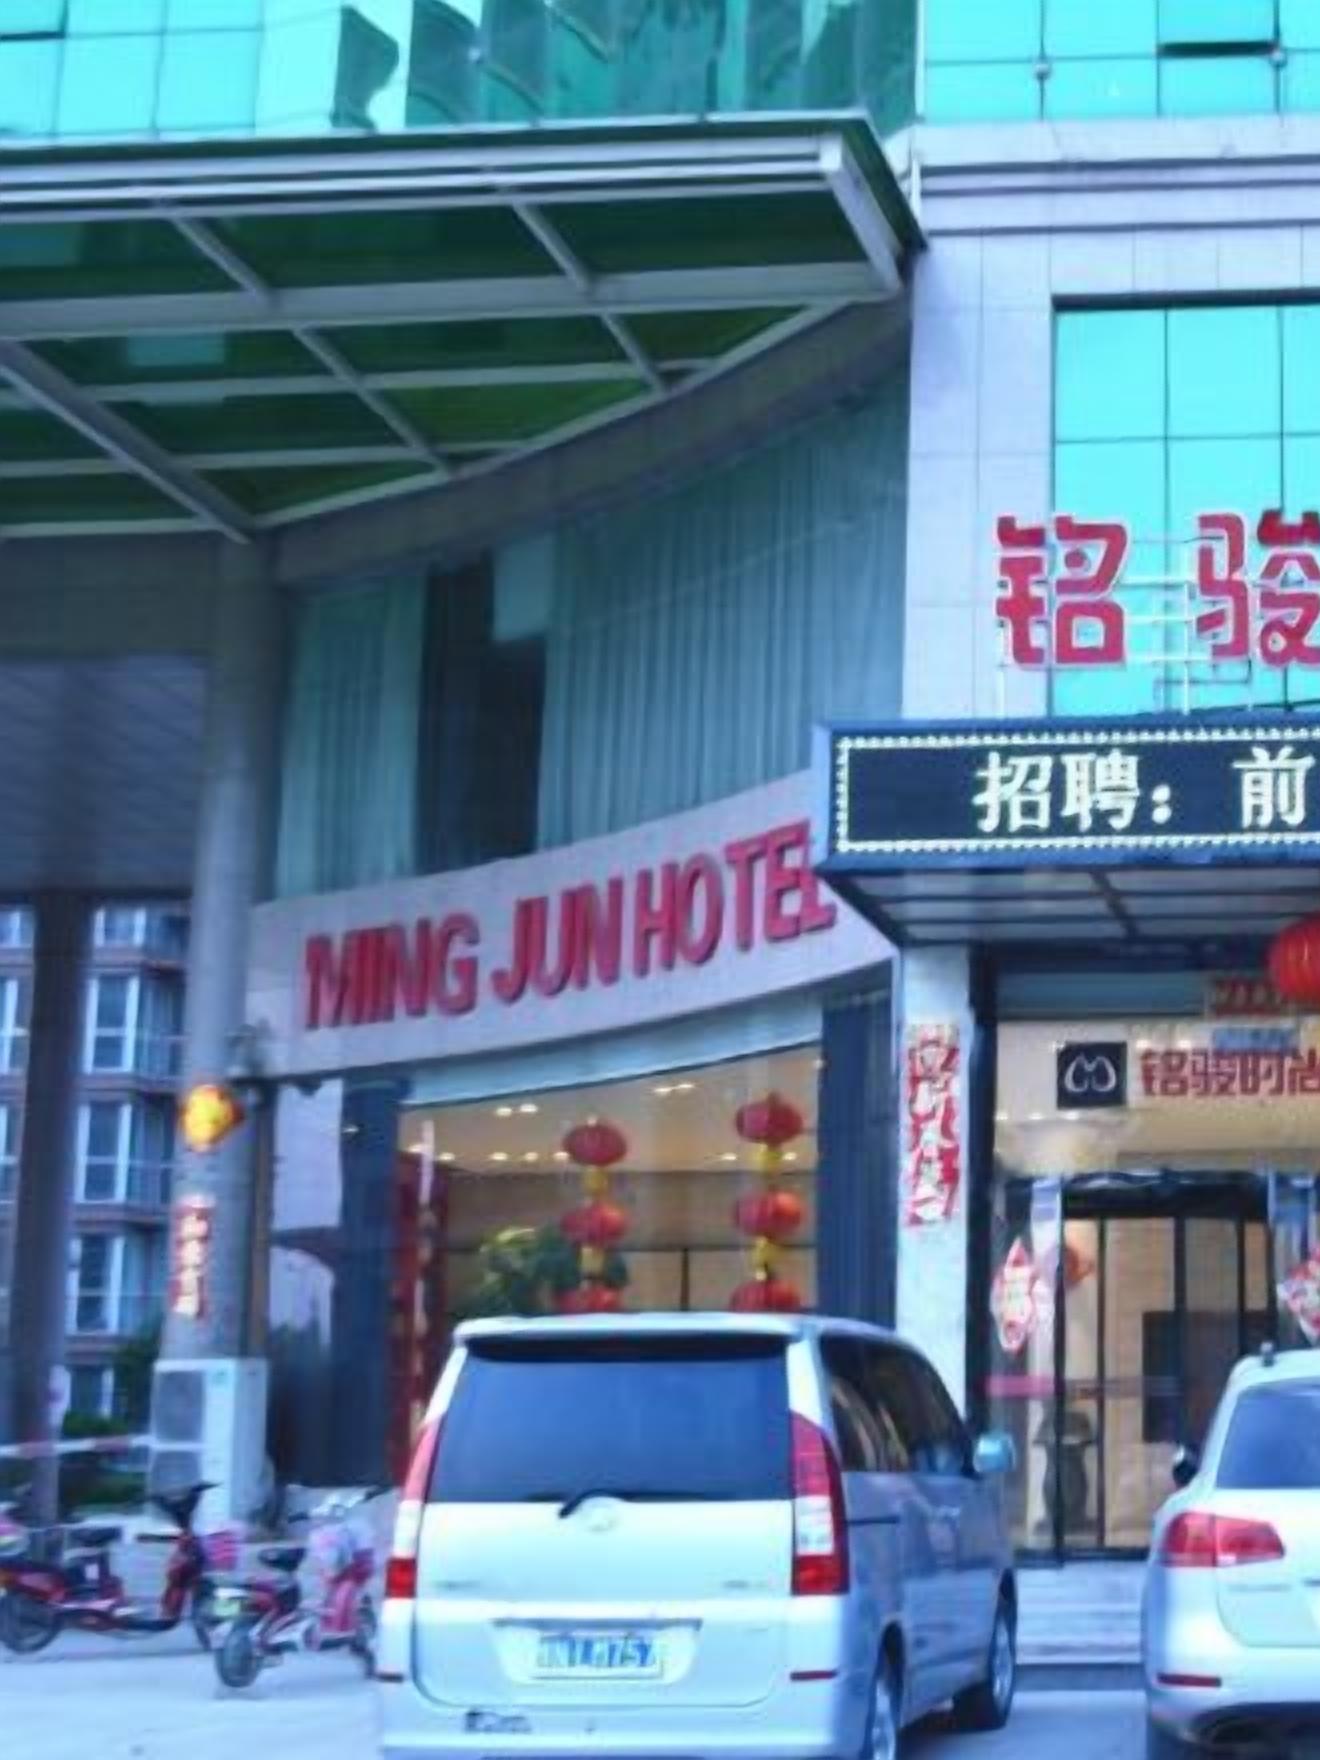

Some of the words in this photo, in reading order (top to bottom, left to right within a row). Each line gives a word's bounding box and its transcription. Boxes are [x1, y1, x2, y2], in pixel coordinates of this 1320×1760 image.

[304, 911, 481, 1031] MING
[491, 875, 624, 1005] JUN
[631, 817, 838, 978] HOTEL
